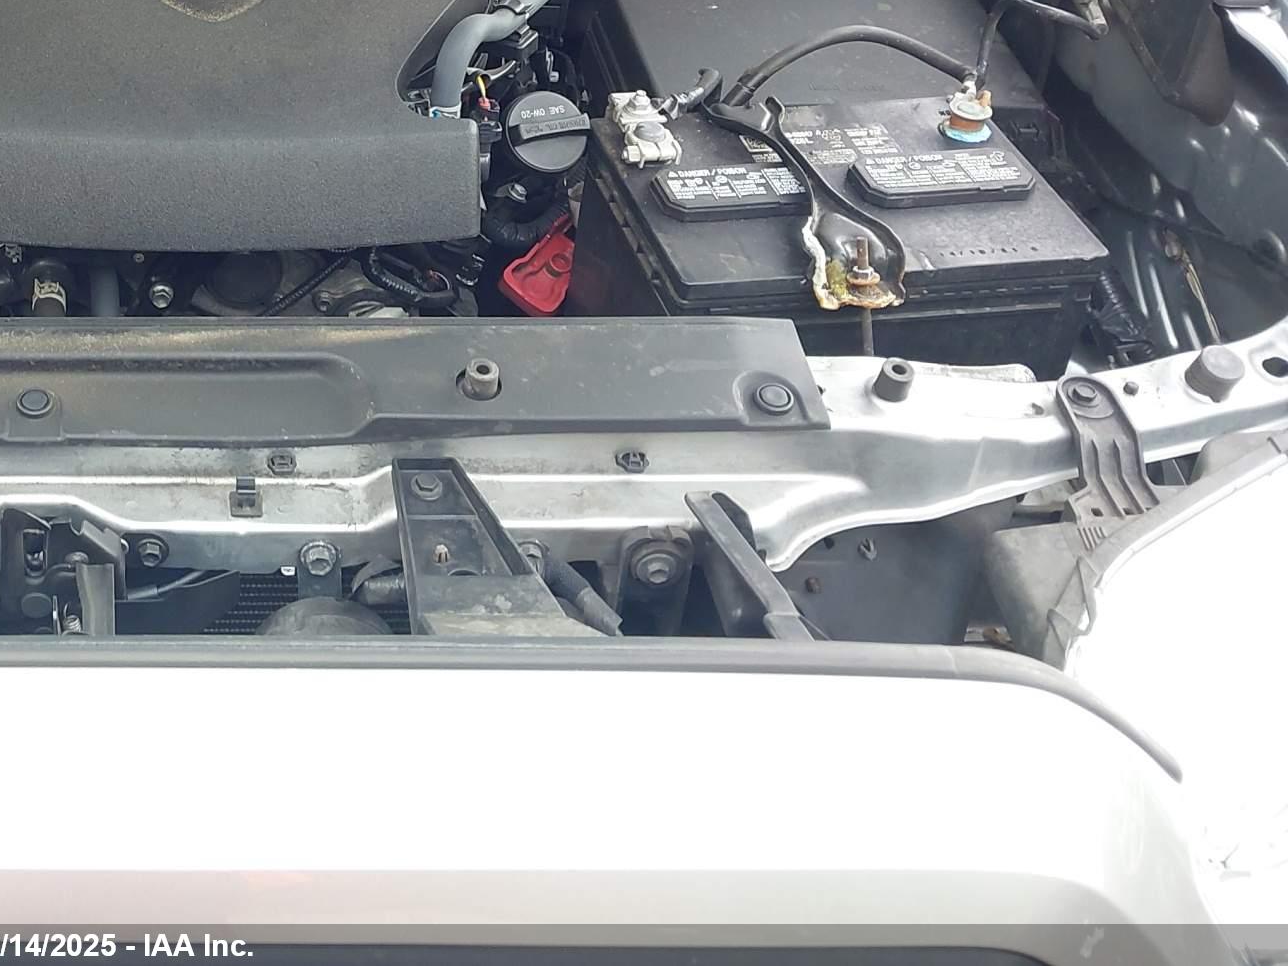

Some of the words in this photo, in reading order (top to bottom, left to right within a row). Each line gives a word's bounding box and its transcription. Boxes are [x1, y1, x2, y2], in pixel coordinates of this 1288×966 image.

[520, 108, 546, 119] 0W-20
[549, 105, 566, 115] SAE
[877, 155, 906, 165] DANGER
[913, 153, 944, 162] POISON
[678, 169, 710, 178] DANGER
[716, 167, 747, 175] POISON
